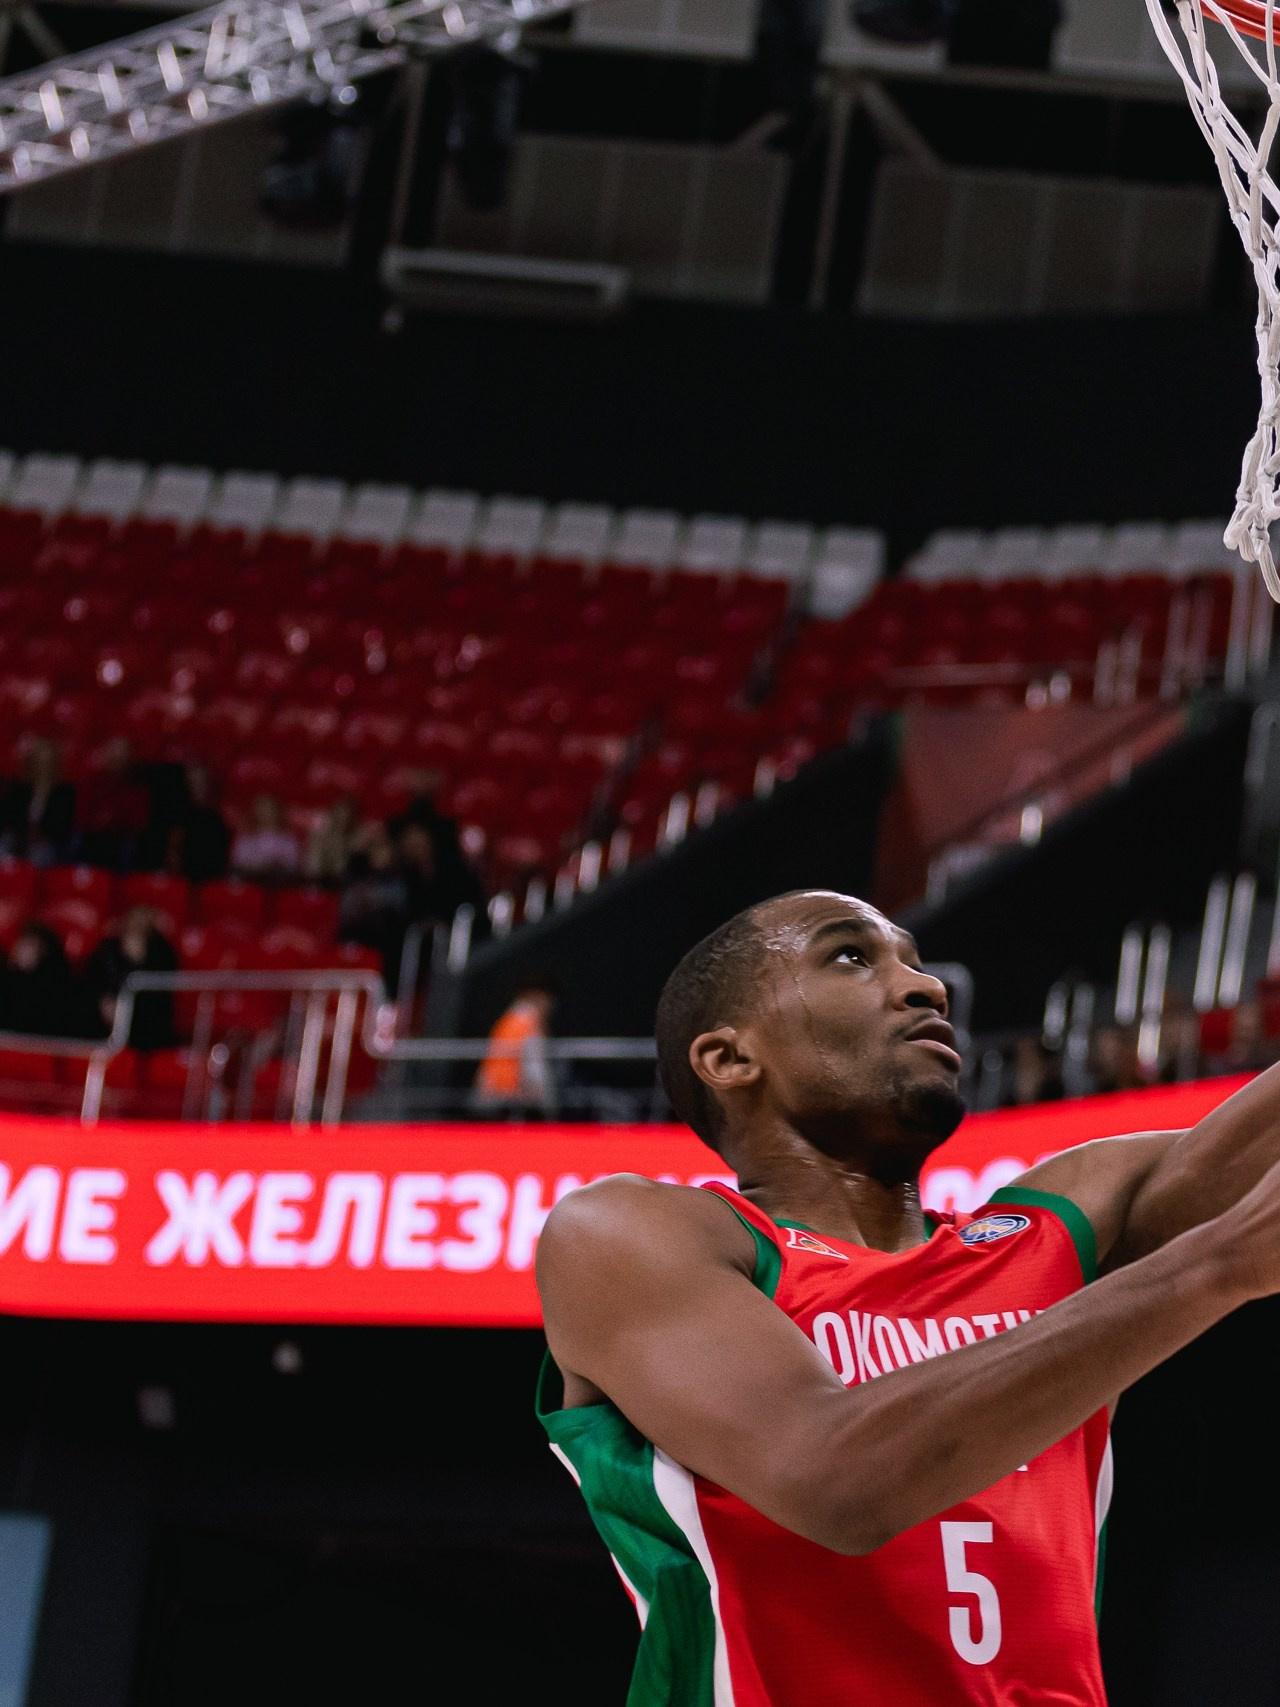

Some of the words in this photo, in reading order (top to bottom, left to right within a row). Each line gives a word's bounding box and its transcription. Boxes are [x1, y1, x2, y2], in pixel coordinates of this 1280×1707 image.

[145, 1170, 740, 1270] ЖЕЛЕЗН
[812, 1309, 1046, 1385] ОКОМОТ
[940, 1521, 1002, 1666] 5
